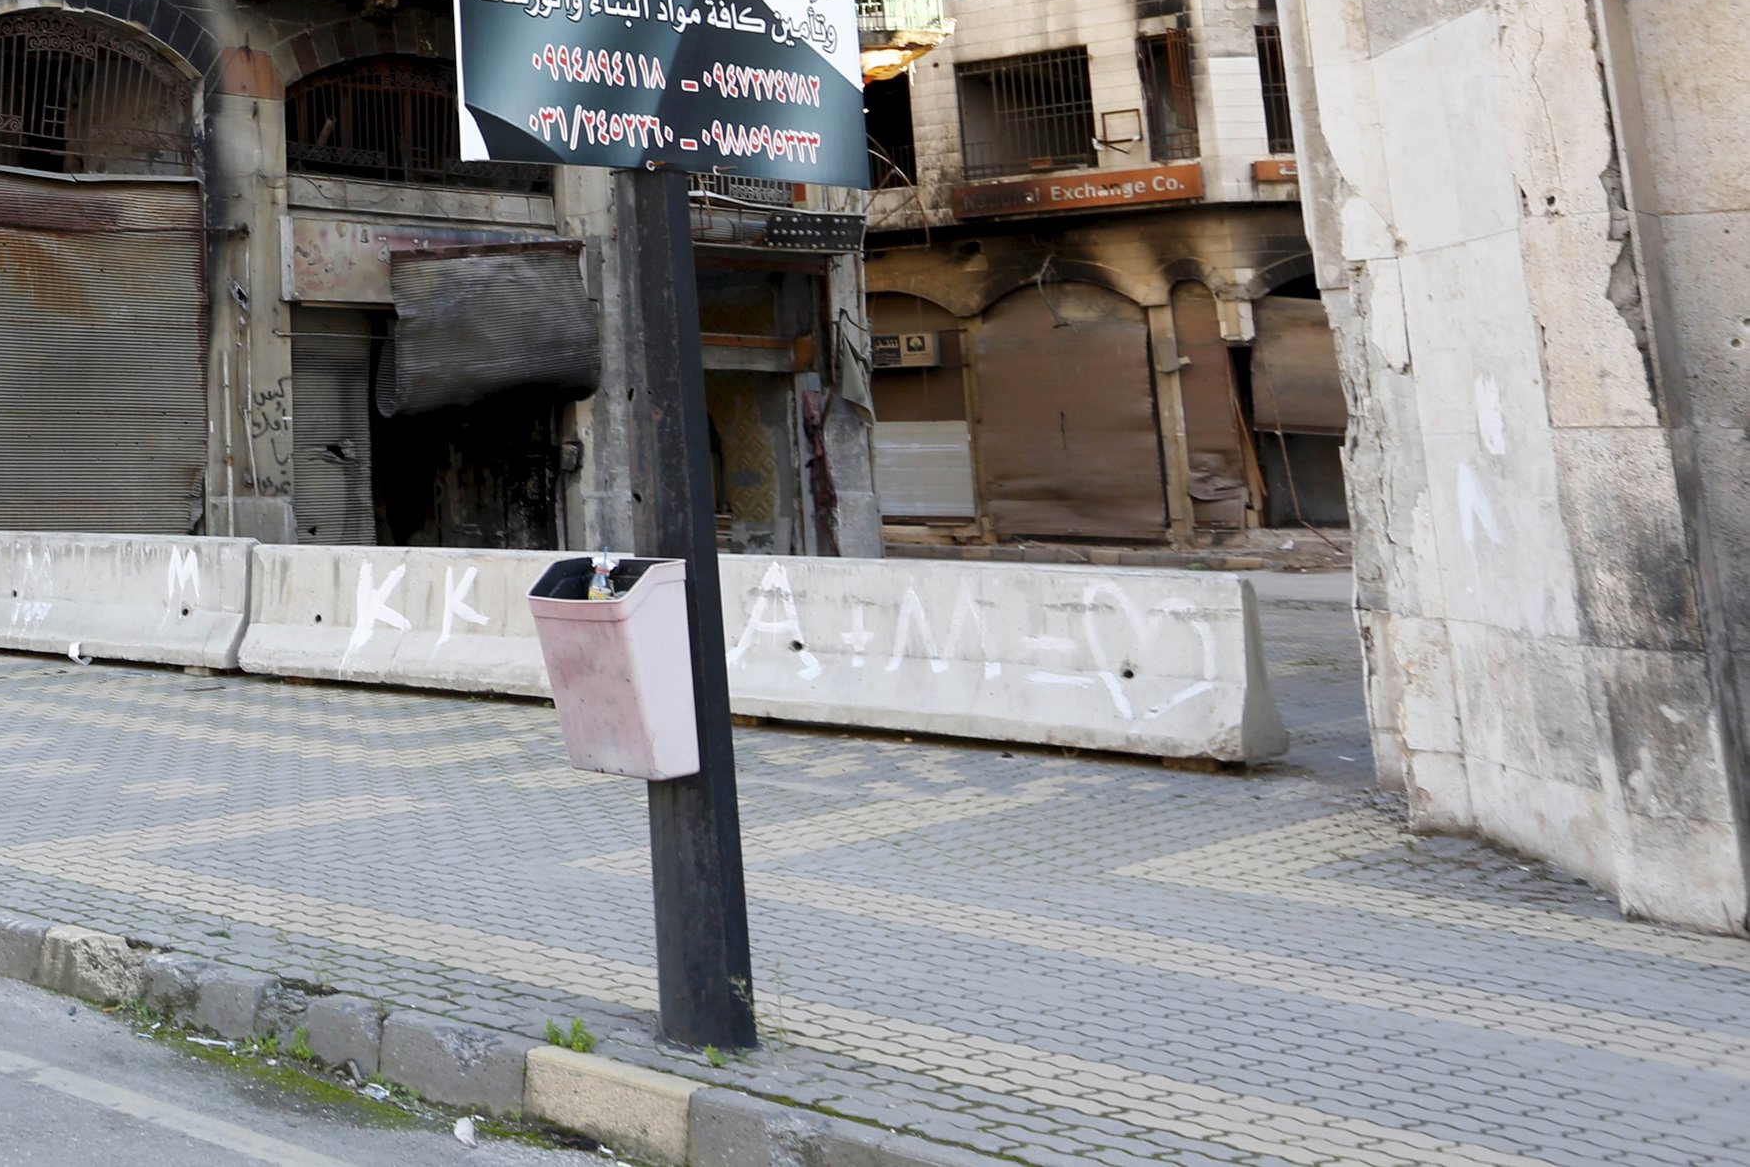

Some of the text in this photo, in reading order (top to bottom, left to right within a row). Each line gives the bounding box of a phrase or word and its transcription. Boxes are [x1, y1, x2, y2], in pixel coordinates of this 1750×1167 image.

[770, 5, 838, 54] وتأمين
[532, 43, 666, 90] ٠٩٩٤٨٩٤١١٨
[1050, 180, 1147, 202] Exchange
[1152, 175, 1185, 192] Co.
